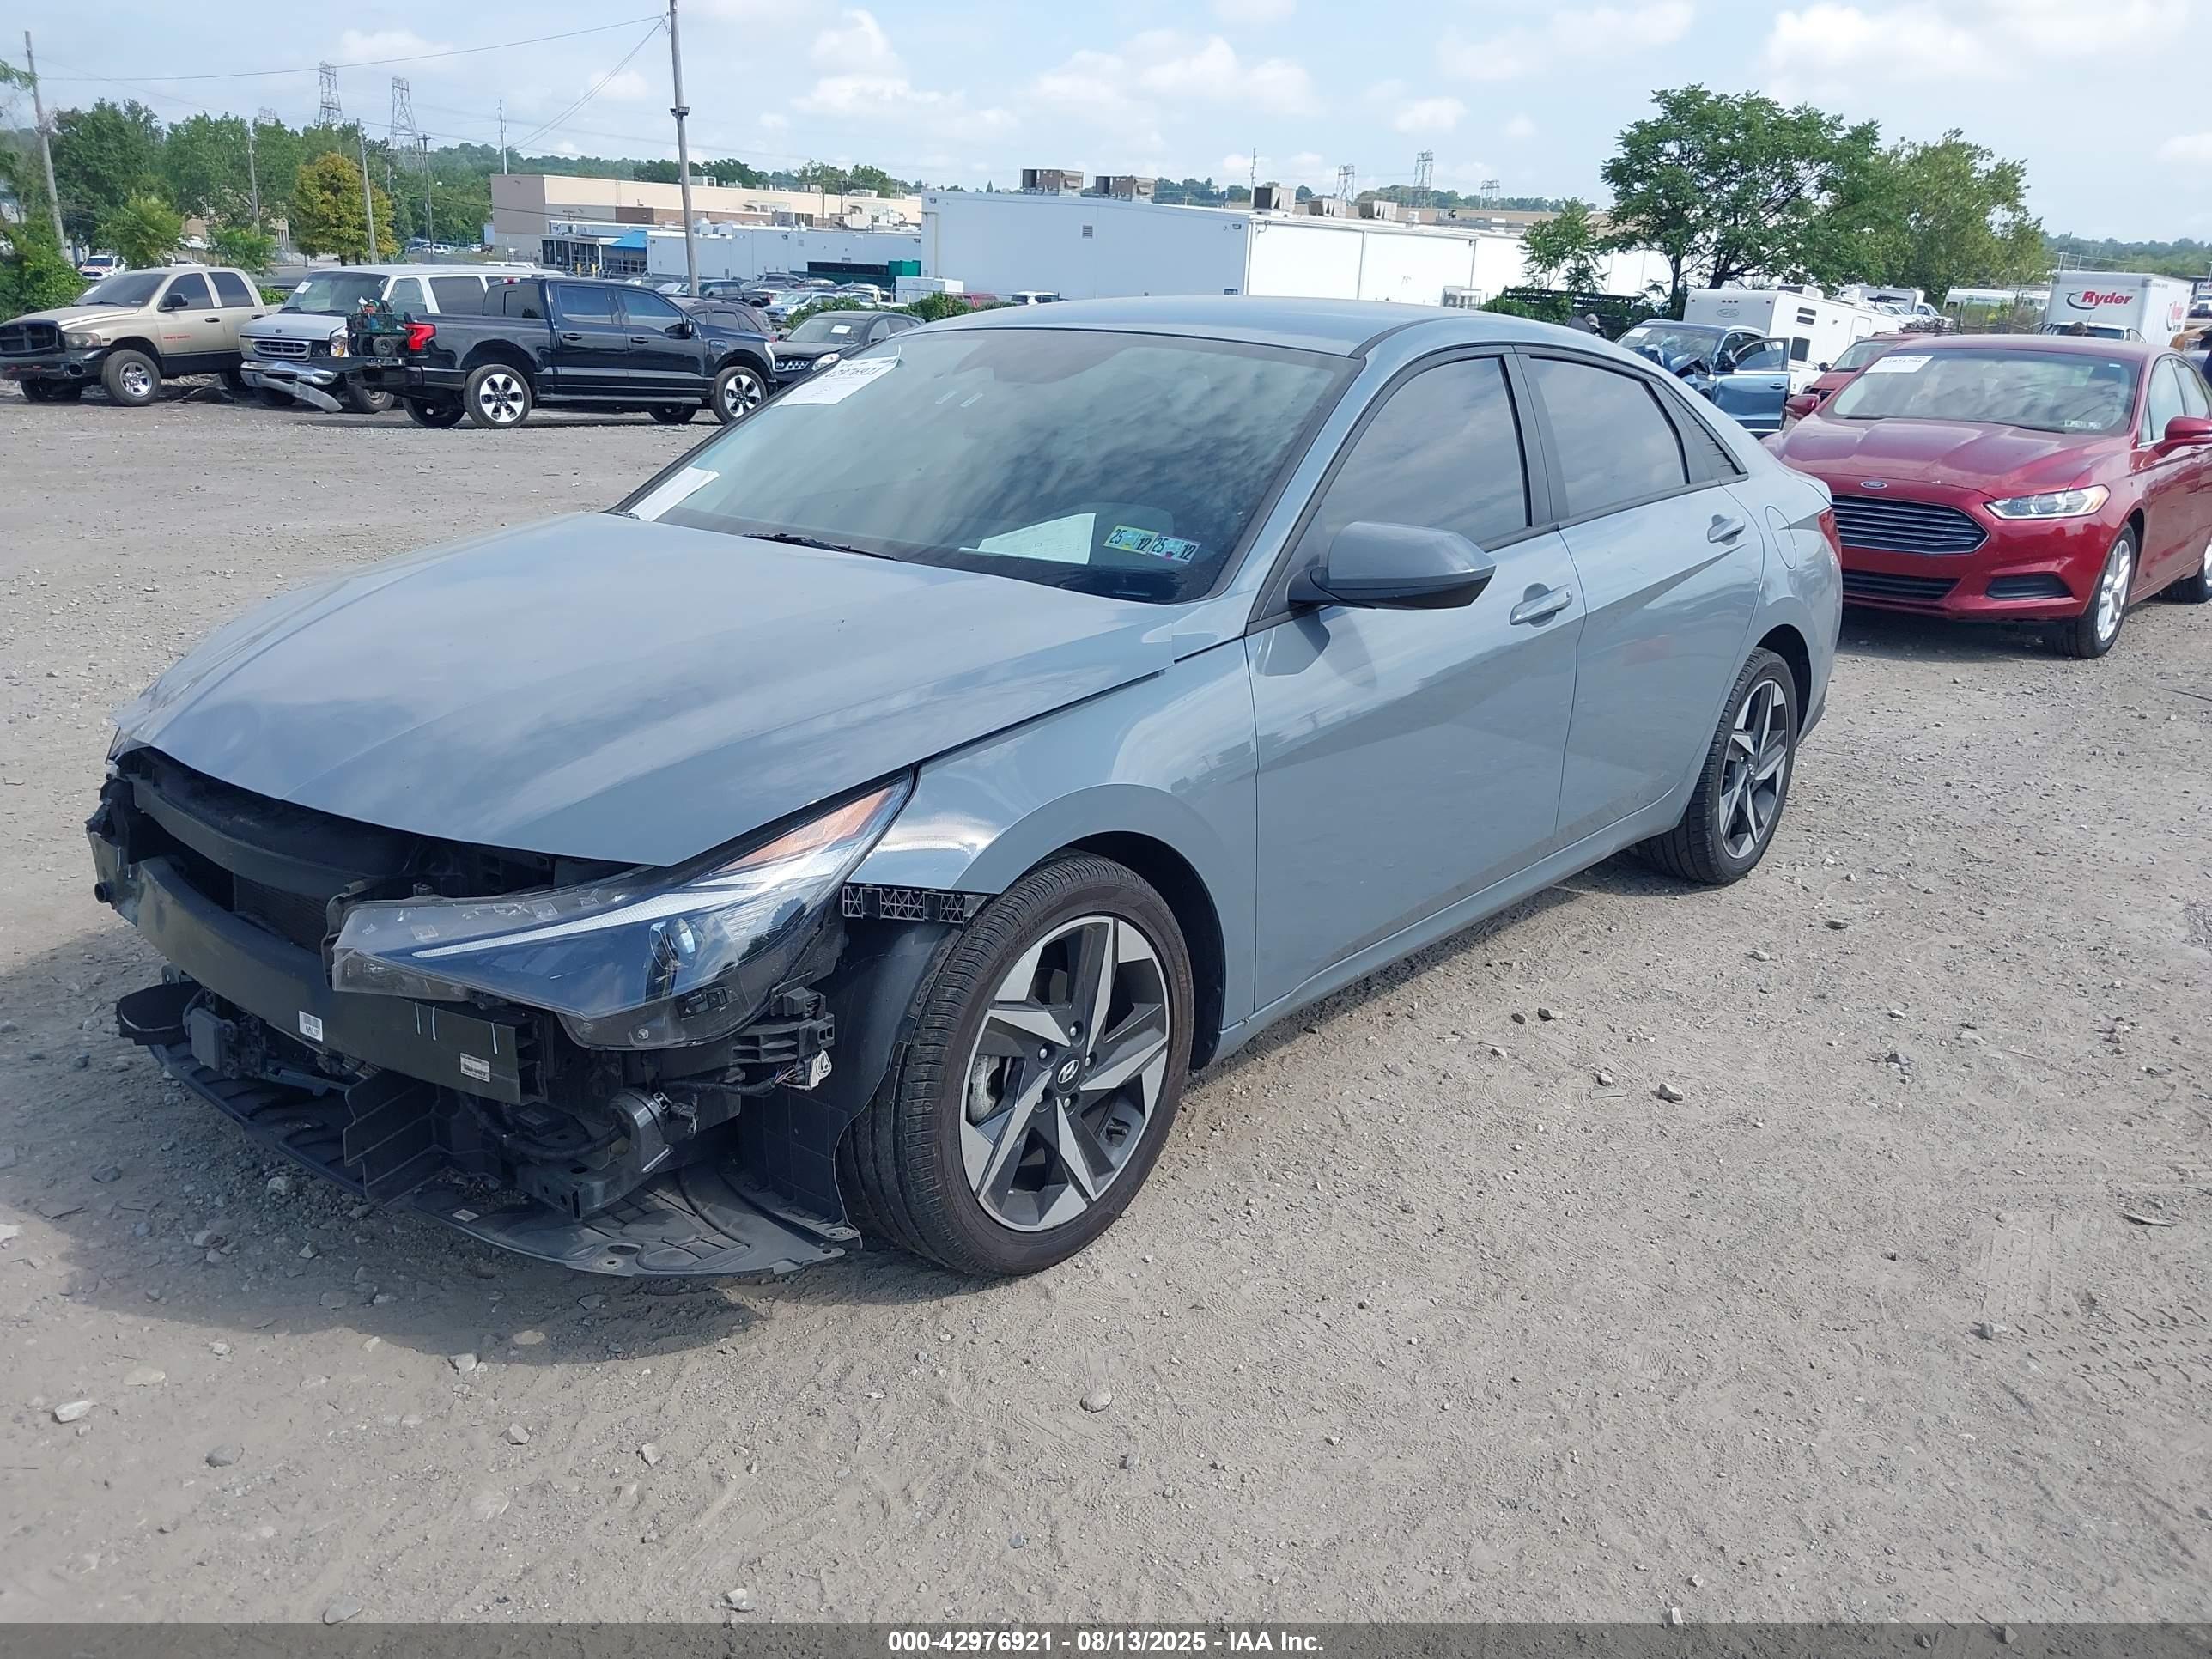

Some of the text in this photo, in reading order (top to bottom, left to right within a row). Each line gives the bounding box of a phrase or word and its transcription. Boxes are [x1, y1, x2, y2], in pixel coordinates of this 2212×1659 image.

[2081, 291, 2133, 306] Ryder
[1109, 528, 1152, 551] 25 12
[1152, 537, 1195, 560] 25 12
